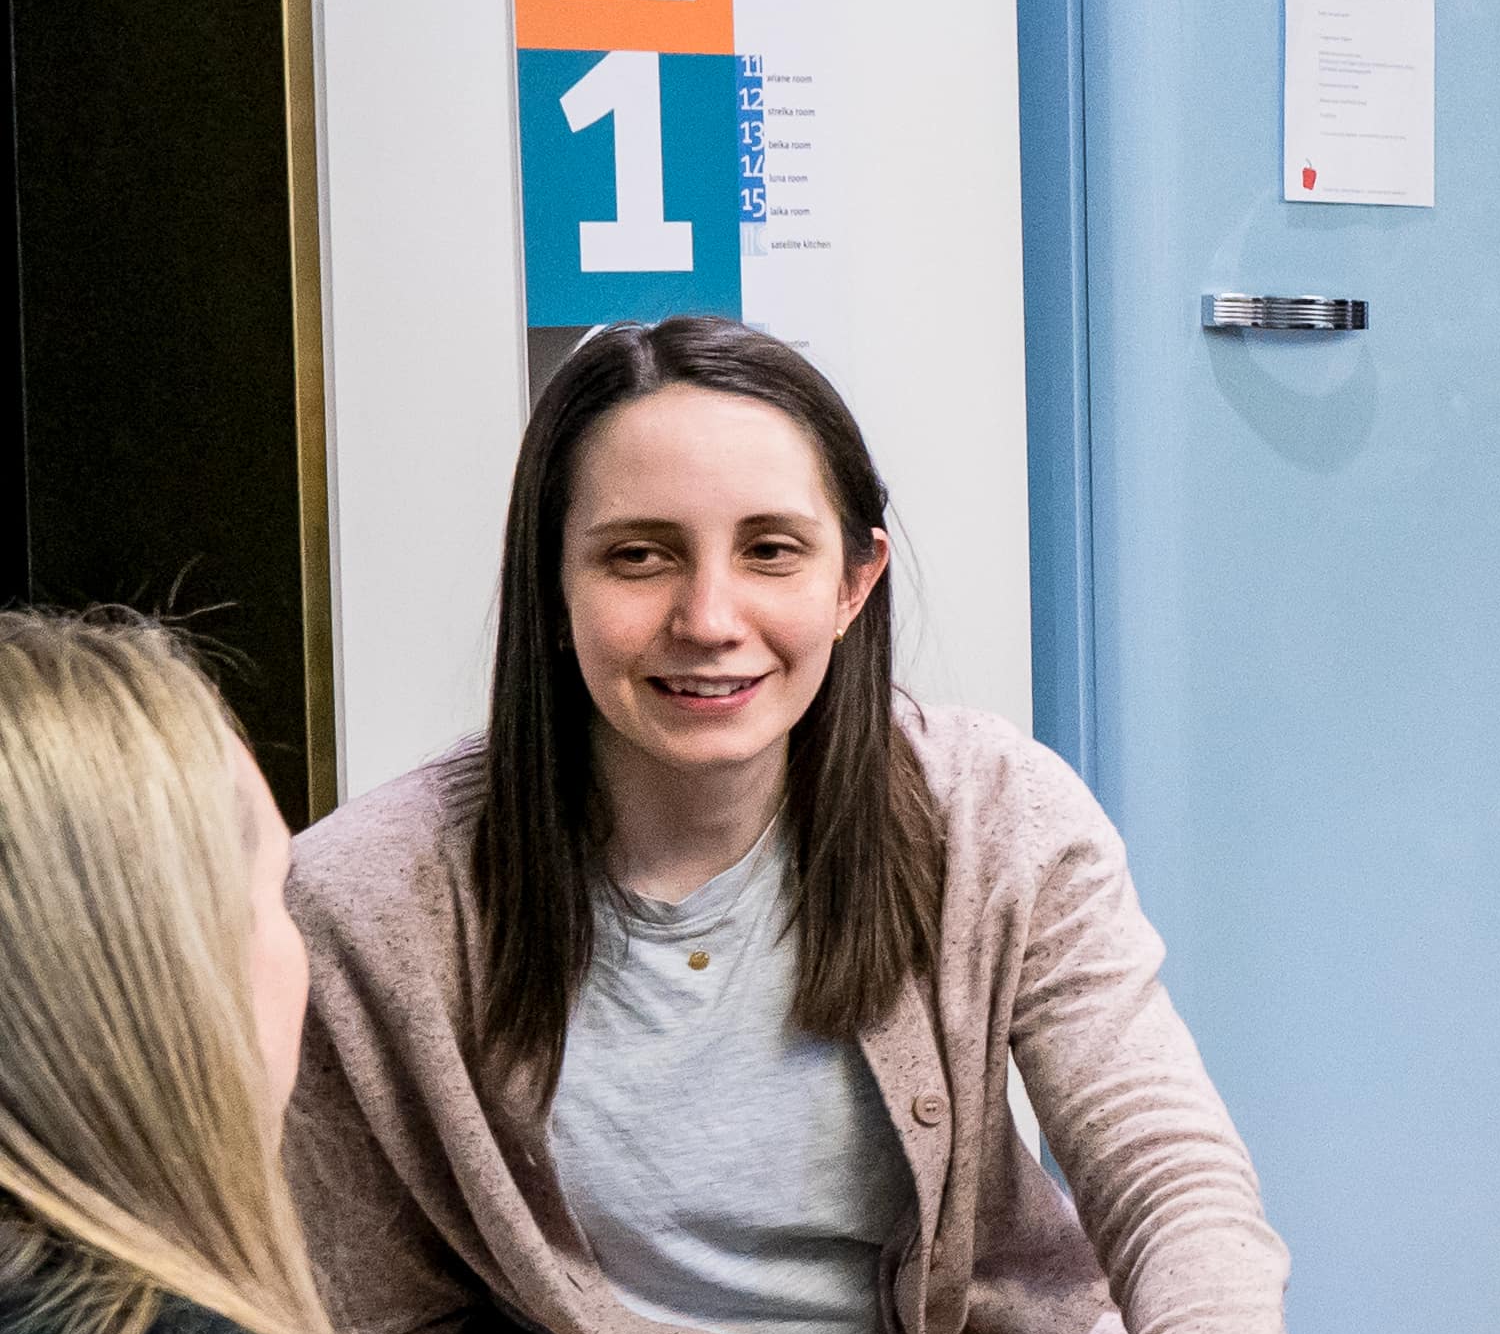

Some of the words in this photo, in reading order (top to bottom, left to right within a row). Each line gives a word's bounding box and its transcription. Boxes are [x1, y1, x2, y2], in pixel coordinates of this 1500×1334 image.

[741, 55, 762, 77] 11
[792, 75, 812, 83] room
[739, 87, 763, 110] 12
[795, 108, 815, 116] room
[740, 121, 764, 151] 13
[791, 141, 811, 149] room
[559, 51, 694, 272] 1
[788, 175, 808, 183] room
[741, 188, 765, 218] 15
[790, 208, 810, 216] room
[803, 240, 831, 249] kitchen
